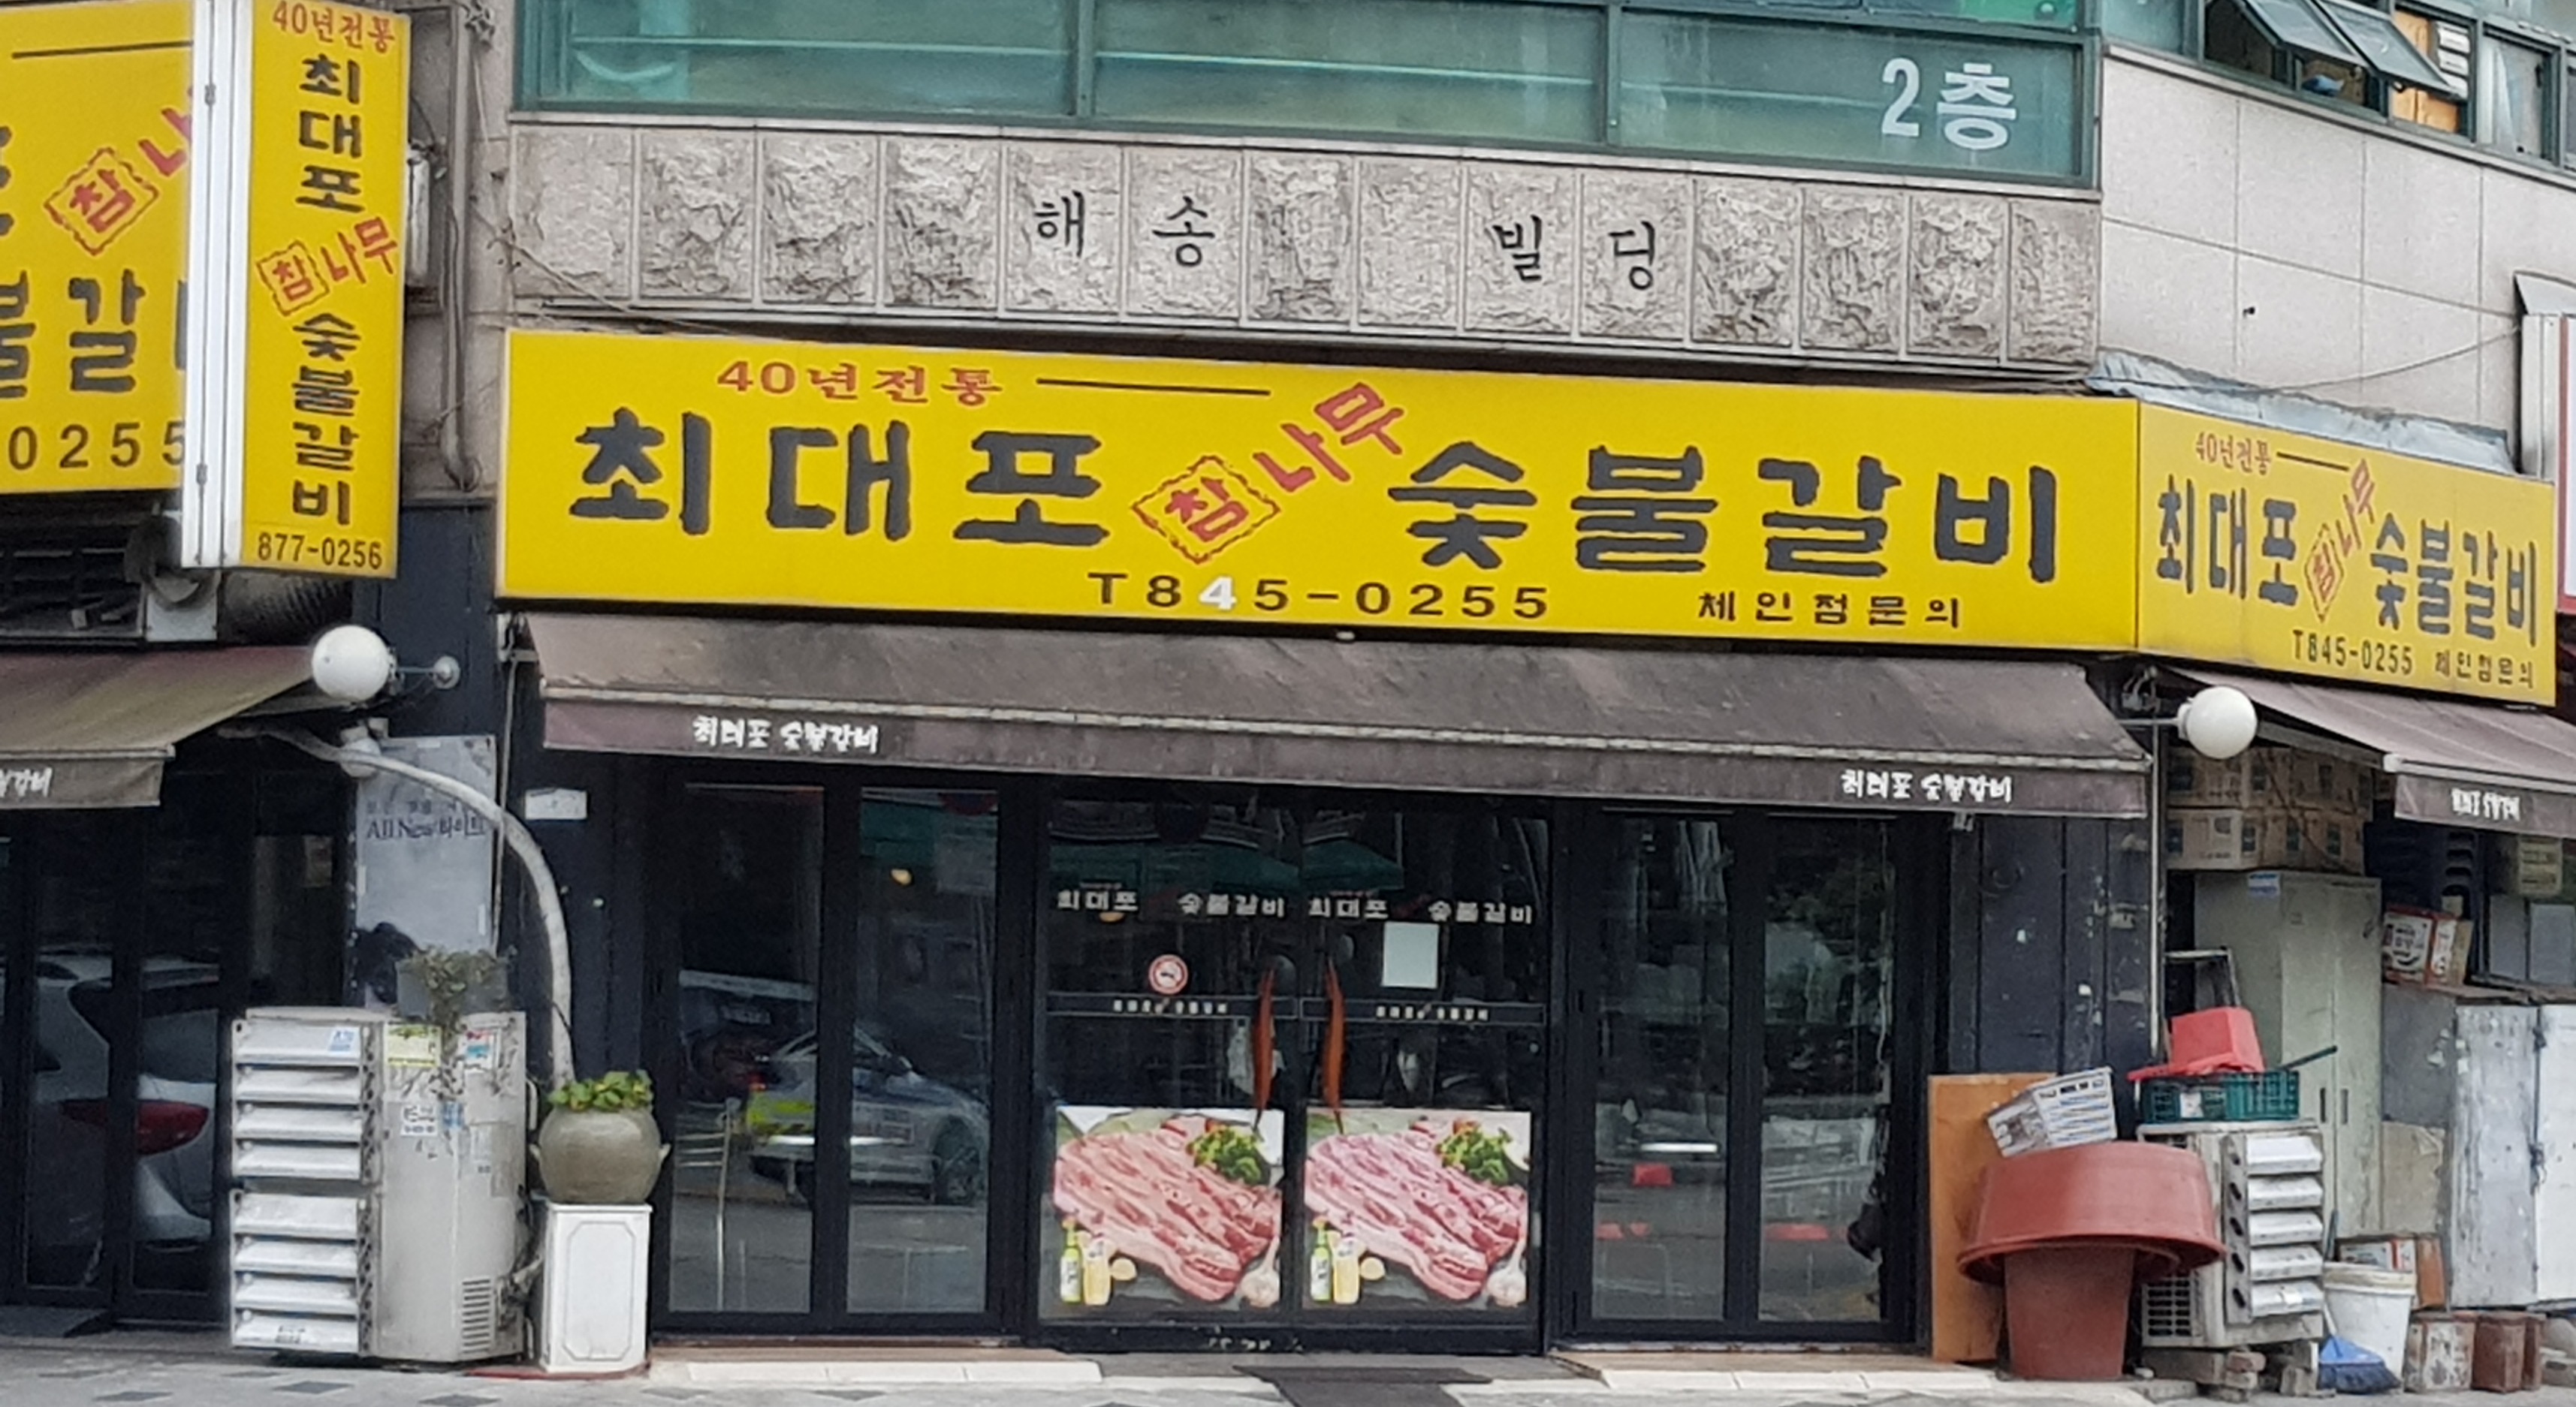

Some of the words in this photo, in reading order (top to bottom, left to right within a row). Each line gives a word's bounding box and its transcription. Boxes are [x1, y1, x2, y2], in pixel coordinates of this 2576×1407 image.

[273, 0, 395, 54] 40년전통
[294, 53, 365, 213] 최대포
[1881, 57, 2018, 151] 2층
[1033, 189, 1216, 268] 해송
[1493, 214, 1656, 291] 빌딩
[291, 312, 361, 526] 숯불갈비
[717, 360, 1003, 406] 40년전통
[2195, 432, 2271, 475] 40년전통
[569, 406, 1111, 547] 최대포
[1388, 440, 2056, 583] 숯불갈비
[258, 533, 382, 569] 877-0256
[2156, 473, 2299, 607] 최대포
[2369, 512, 2537, 647] 숯불갈비
[1698, 591, 1960, 628] 체인점문의
[2436, 649, 2533, 689] 체인점문의
